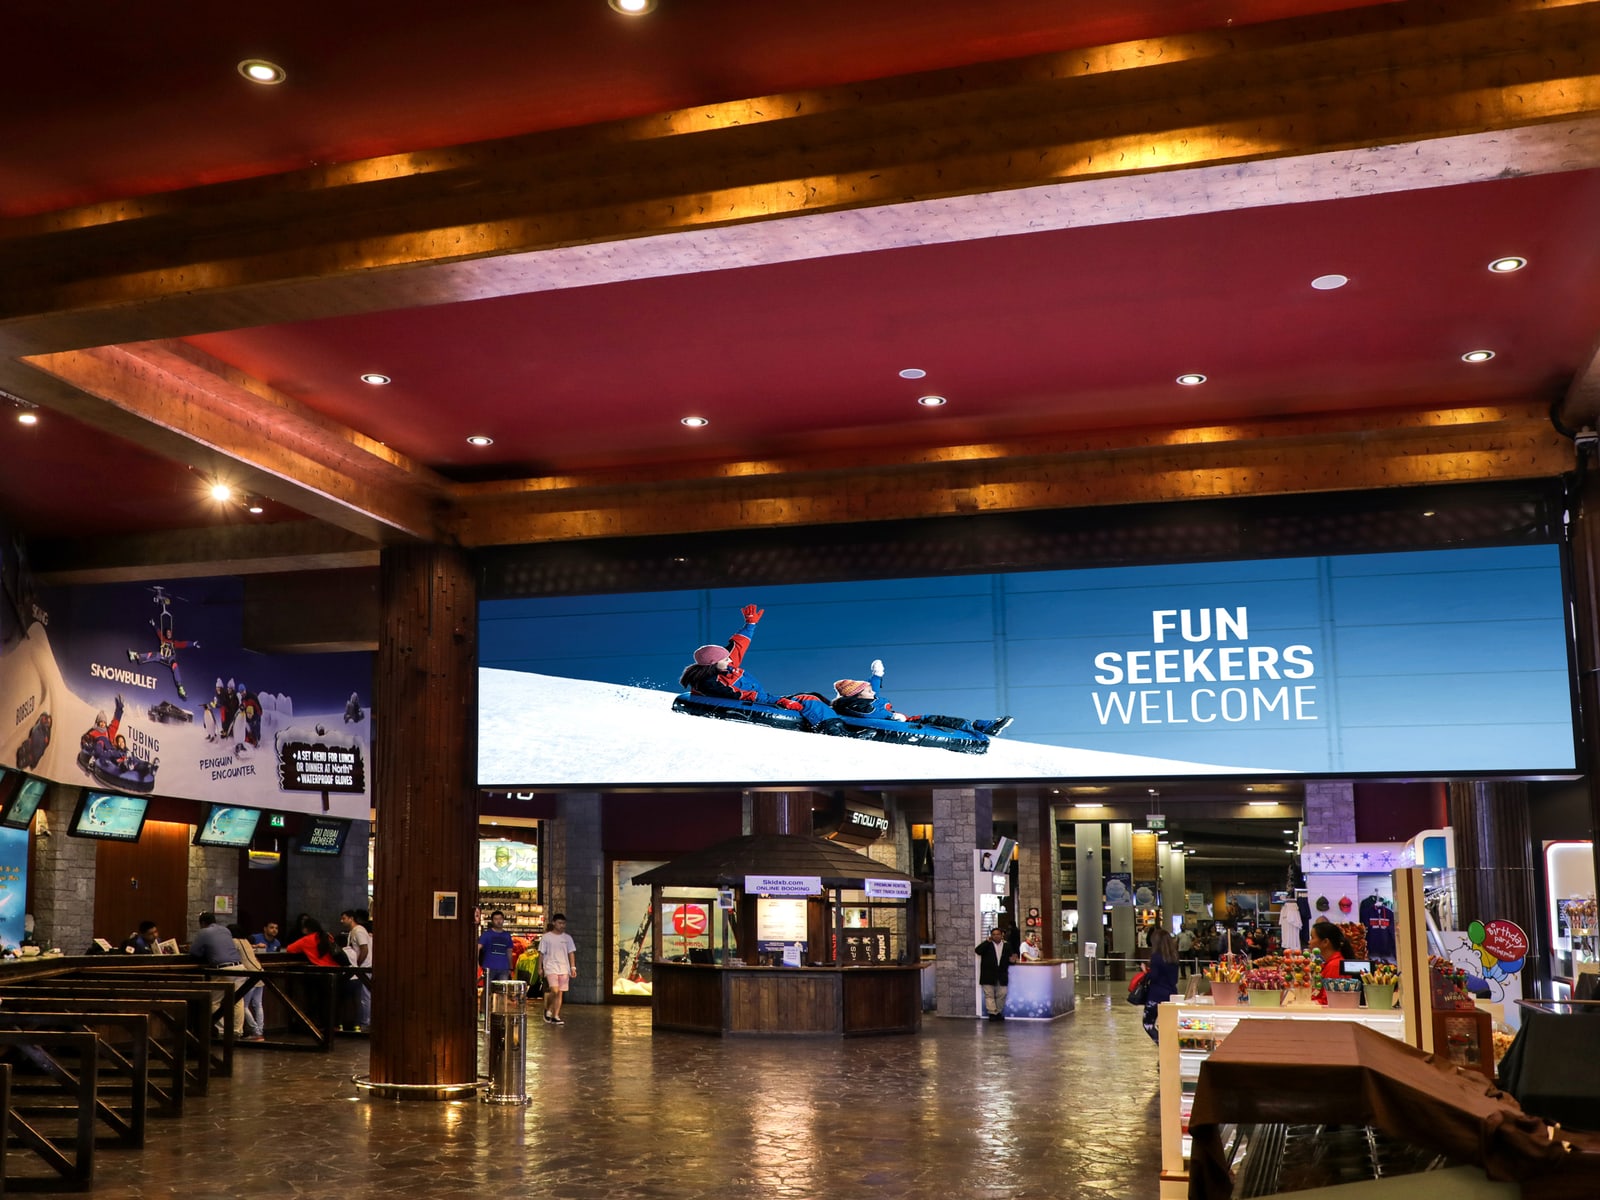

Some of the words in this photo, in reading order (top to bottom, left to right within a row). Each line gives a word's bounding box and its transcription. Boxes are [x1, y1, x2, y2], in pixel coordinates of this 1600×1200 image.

[1152, 606, 1249, 644] FUN
[1094, 645, 1315, 685] SEEKERS
[91, 663, 158, 690] SNOWBULLET
[16, 695, 35, 726] BOBSLED
[1091, 685, 1319, 725] WELCOME
[128, 725, 160, 752] TUBING
[133, 742, 150, 762] RUN
[297, 750, 302, 761] A
[302, 750, 312, 761] SET
[312, 751, 327, 762] MENU
[328, 752, 338, 762] FOR
[338, 753, 355, 764] LUNCH
[199, 756, 233, 771] PENGUIN
[296, 762, 304, 772] OR
[305, 762, 324, 773] DINNER
[325, 763, 331, 773] AT
[212, 764, 256, 781] ENCOUNTER
[301, 774, 334, 784] WATERPROOF
[335, 775, 353, 785] GLOVES
[852, 812, 876, 828] SNOW
[310, 836, 337, 846] MEMBERS
[313, 828, 323, 838] SKI
[323, 829, 339, 839] DUBAI
[1486, 923, 1526, 949] Birthday
[1494, 936, 1514, 949] party
